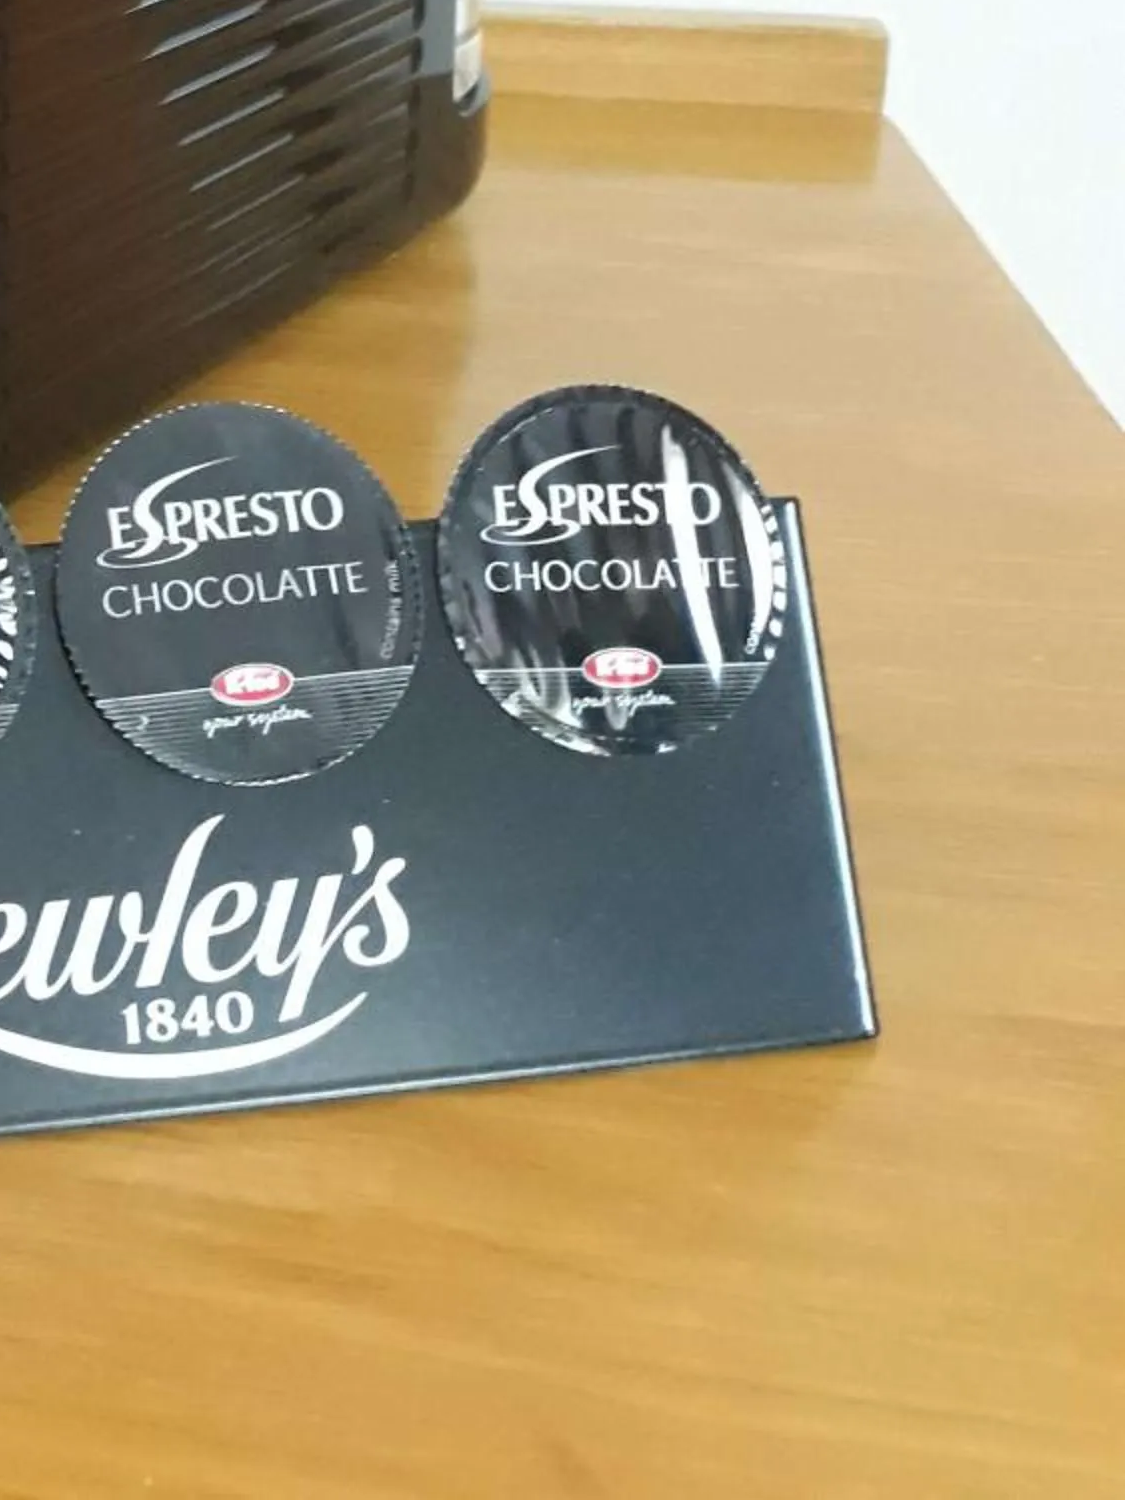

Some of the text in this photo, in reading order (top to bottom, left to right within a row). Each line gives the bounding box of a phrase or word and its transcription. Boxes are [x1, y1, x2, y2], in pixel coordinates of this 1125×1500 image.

[96, 455, 343, 569] ESPRESTO
[480, 444, 722, 547] ESPRESTO
[102, 561, 368, 619] CHOCOLATTE
[122, 991, 254, 1045] 1840
